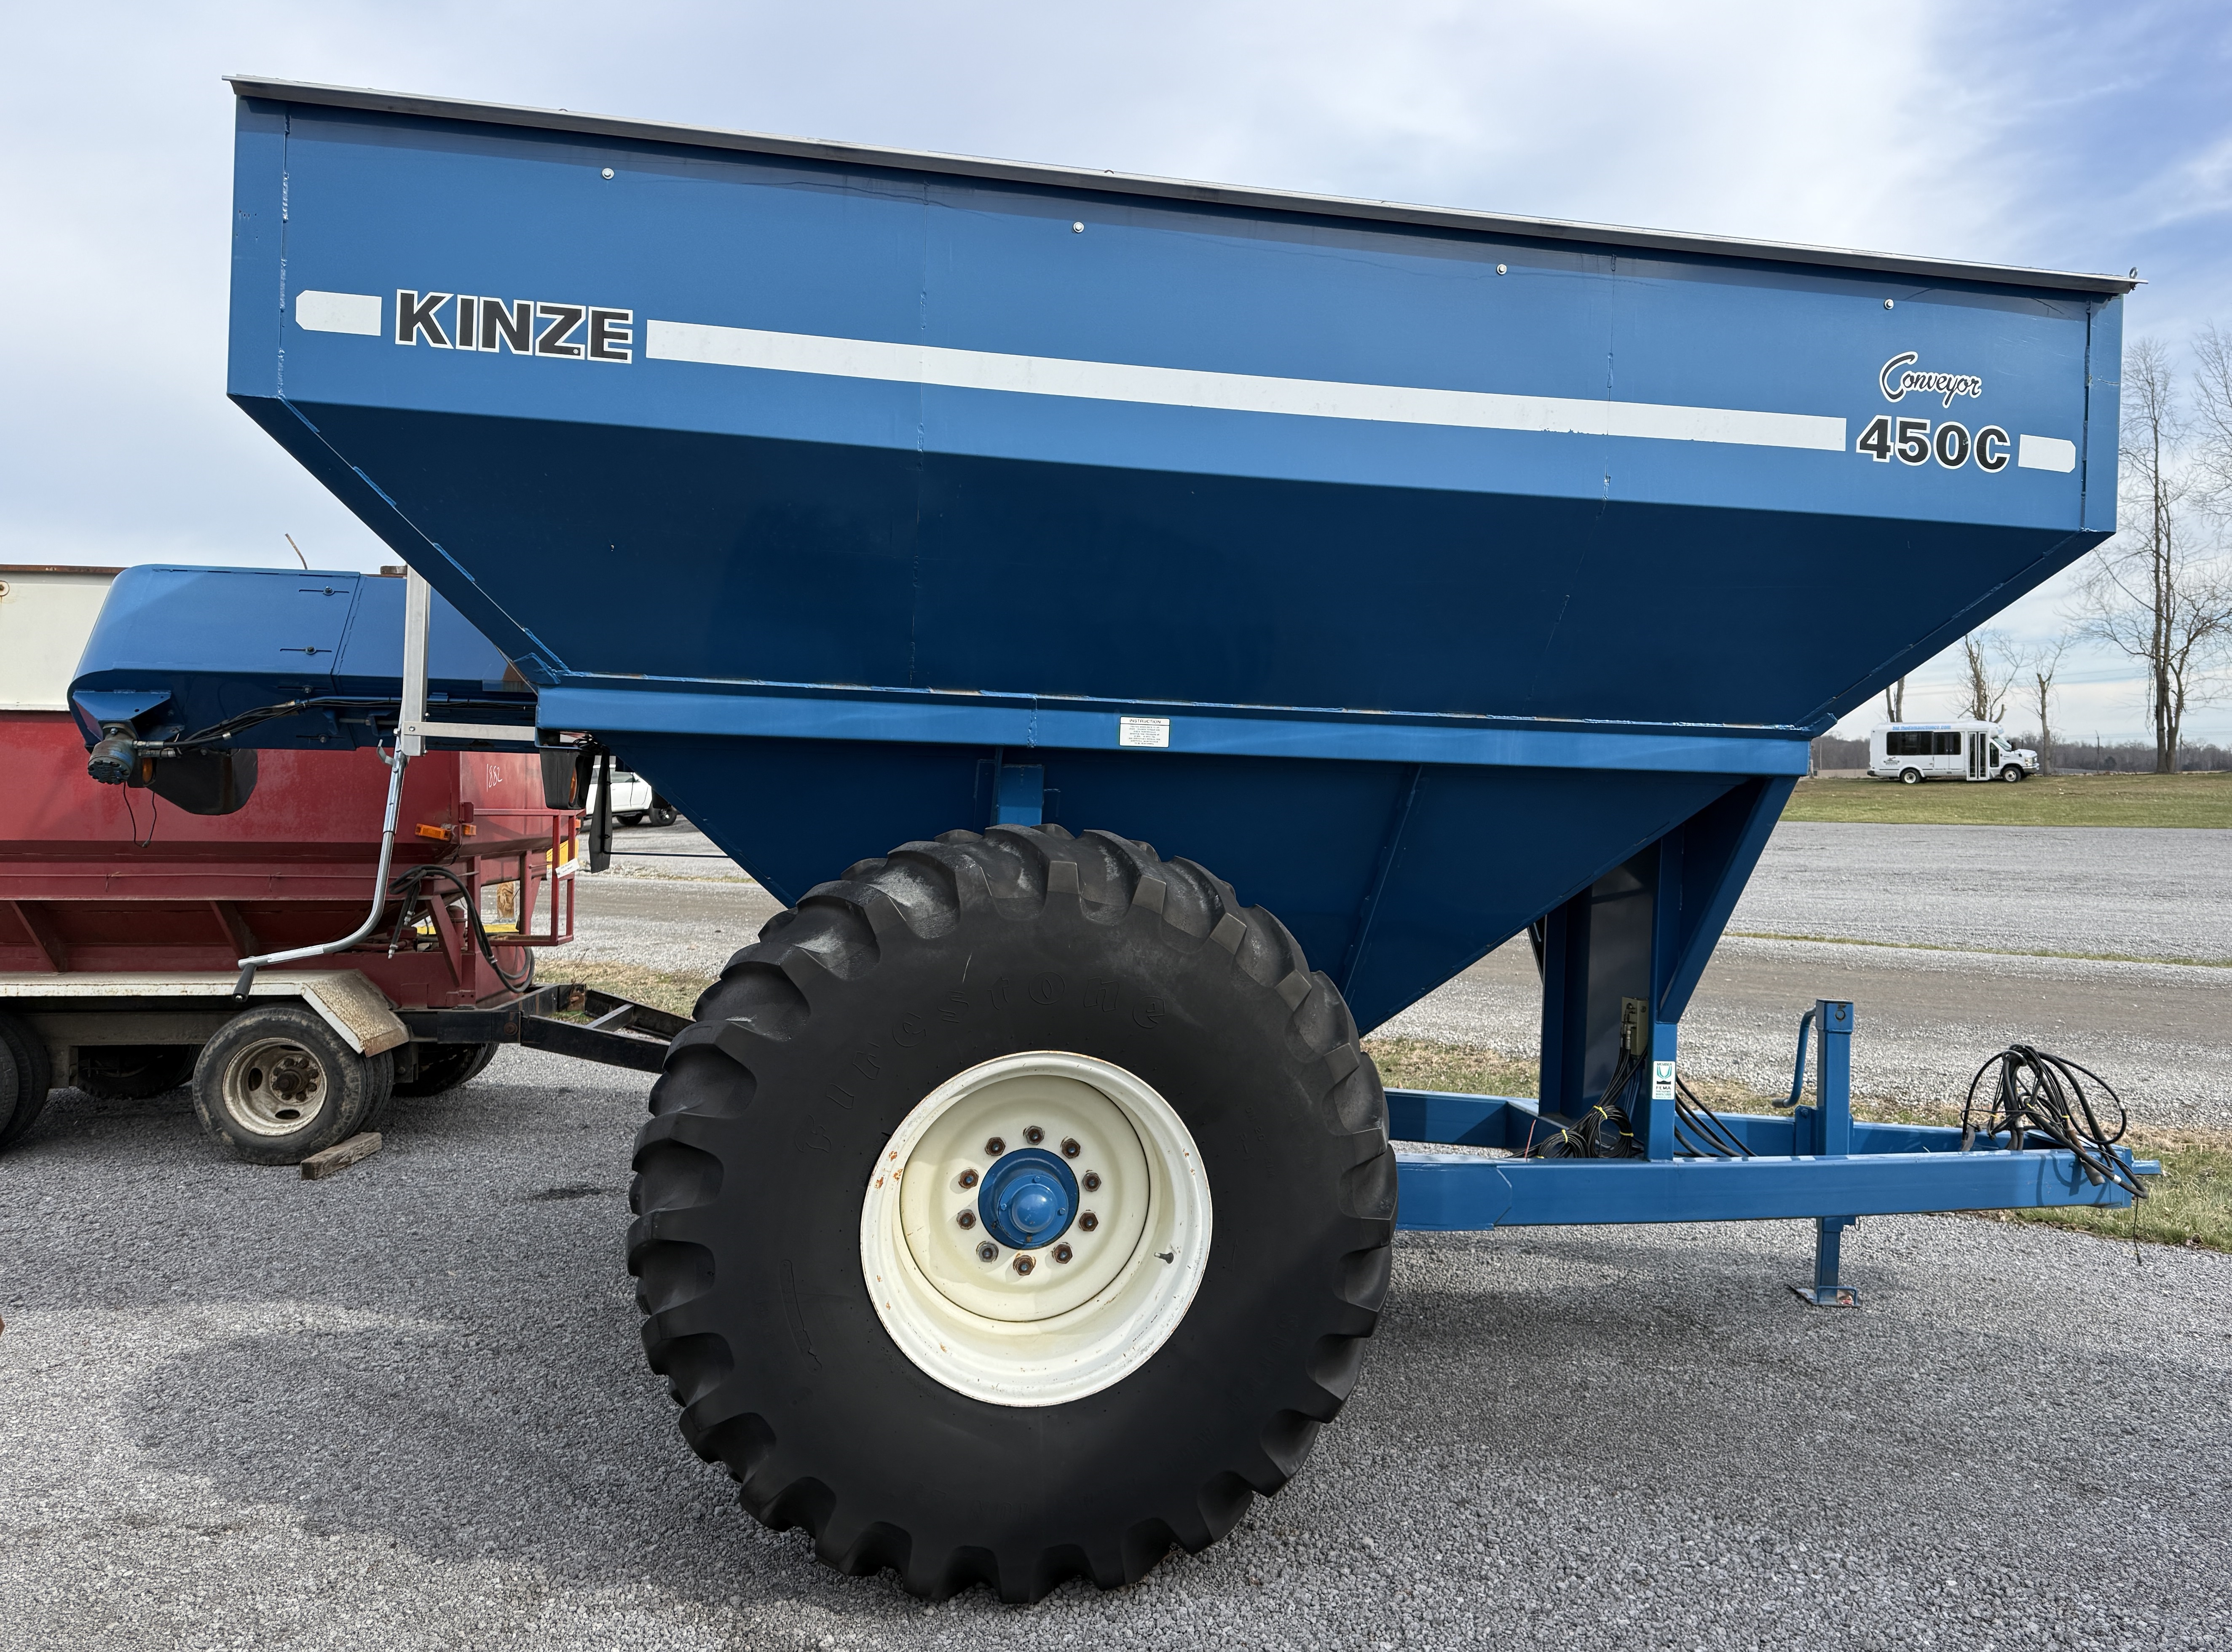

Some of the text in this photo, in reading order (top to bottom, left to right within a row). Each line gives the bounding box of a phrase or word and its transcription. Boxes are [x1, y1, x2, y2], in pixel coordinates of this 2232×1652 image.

[395, 289, 633, 364] KINZE
[1879, 351, 1982, 408] Conveyor
[1856, 415, 2011, 473] 450C
[486, 763, 503, 792] 1882
[795, 971, 1166, 1153] Firestone
